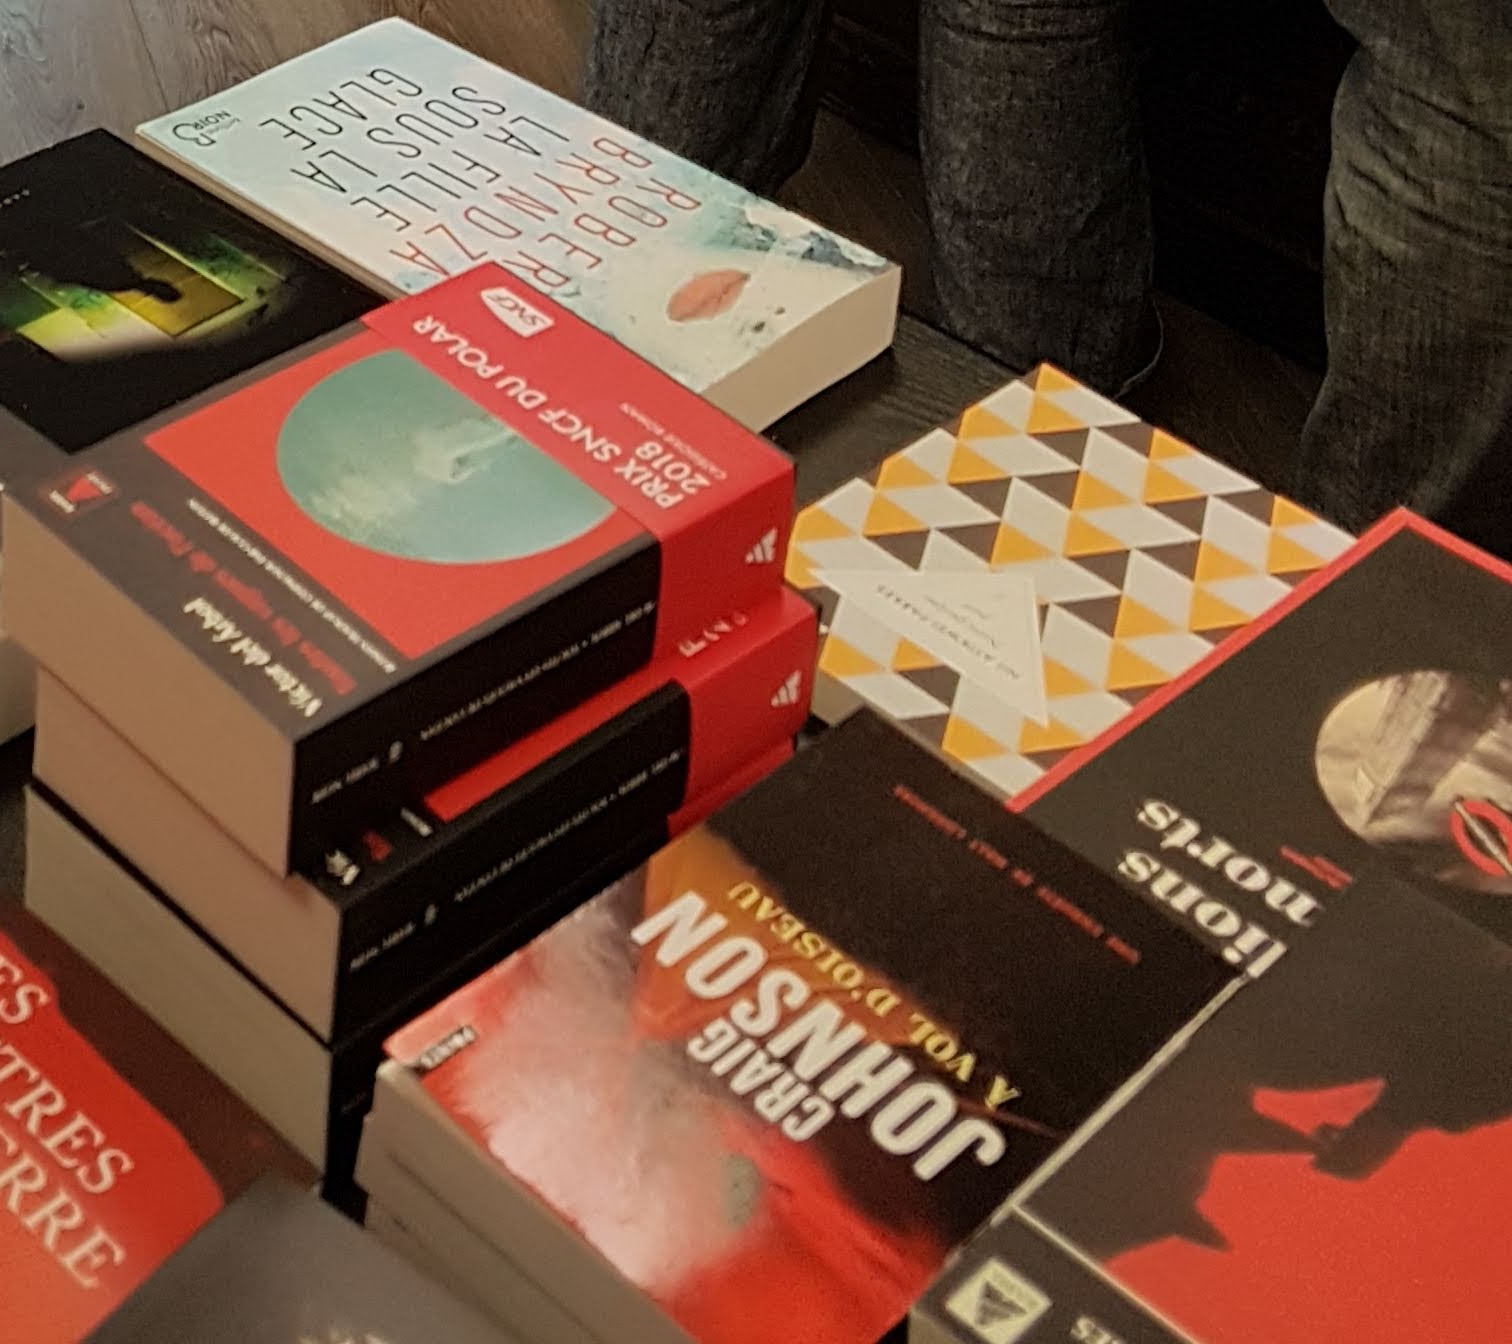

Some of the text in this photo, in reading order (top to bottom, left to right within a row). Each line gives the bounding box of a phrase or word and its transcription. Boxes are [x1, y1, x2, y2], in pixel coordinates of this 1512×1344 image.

[193, 110, 231, 128] NOIR
[259, 68, 422, 158] GLACE
[291, 85, 507, 194] SOUS LA
[350, 116, 570, 231] LA FILLE
[390, 137, 652, 275] BRYNDZA
[528, 181, 701, 289] ROBER
[413, 315, 682, 508] PRIX SNCF DU POLAR
[636, 440, 709, 493] 2018
[727, 880, 903, 1018] D'OISEAU
[630, 890, 1008, 1183] JOHNSON
[687, 1017, 838, 1144] CRAIG
[908, 1020, 980, 1082] VOL
